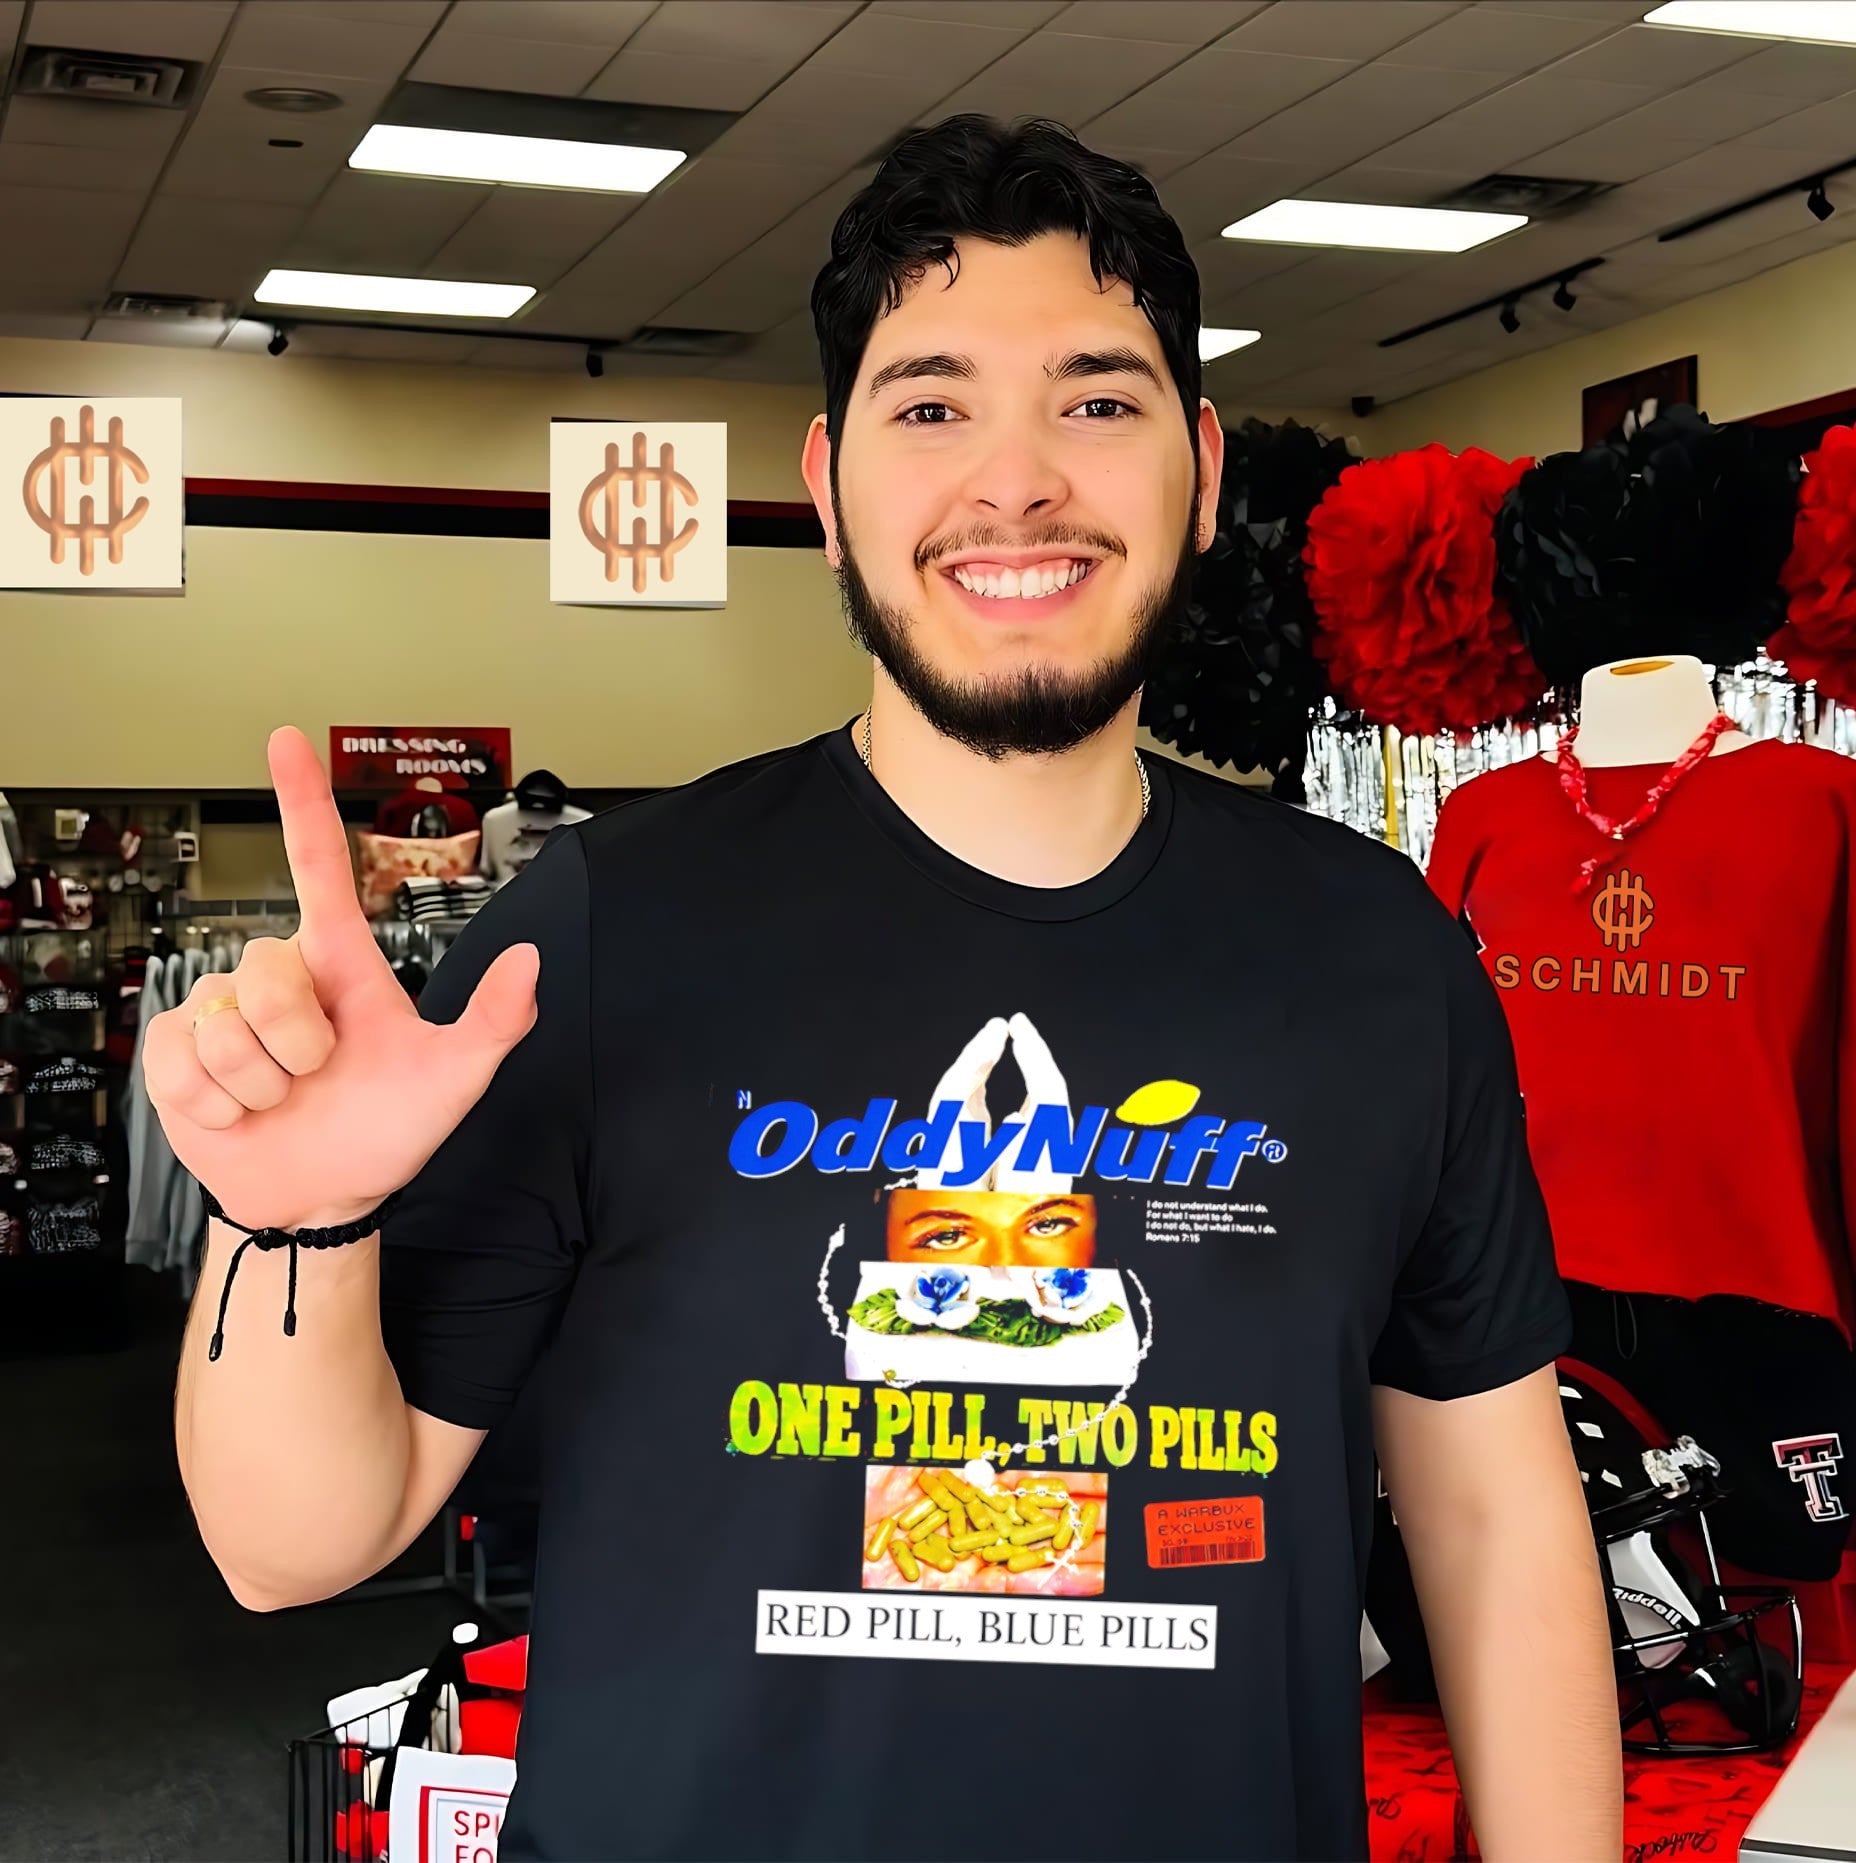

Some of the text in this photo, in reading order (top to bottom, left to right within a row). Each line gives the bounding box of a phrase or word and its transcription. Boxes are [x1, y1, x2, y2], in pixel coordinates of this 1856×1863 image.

[342, 737, 467, 753] DRESSING
[396, 758, 487, 775] ROOMS
[1494, 954, 1746, 1000] SCHMIDT
[1151, 1200, 1163, 1209] do
[1164, 1201, 1179, 1210] not
[1180, 1202, 1227, 1211] understand
[1228, 1203, 1249, 1212] what
[1146, 1210, 1161, 1219] For
[1162, 1211, 1183, 1220] what
[1189, 1212, 1210, 1221] want
[1211, 1213, 1221, 1221] to
[1221, 1213, 1234, 1222] do
[1150, 1221, 1162, 1230] do
[1163, 1222, 1178, 1230] not
[1193, 1222, 1208, 1231] but
[1209, 1223, 1230, 1232] what
[1145, 1232, 1200, 1243] Romans 7:15
[729, 1379, 1279, 1473] ONE PILL, TWO PILLS
[1158, 1504, 1245, 1519] A WARBUX
[1158, 1518, 1255, 1535] EXCLUSIVE
[765, 1604, 1210, 1652] RED PILL, BLUE PILLS
